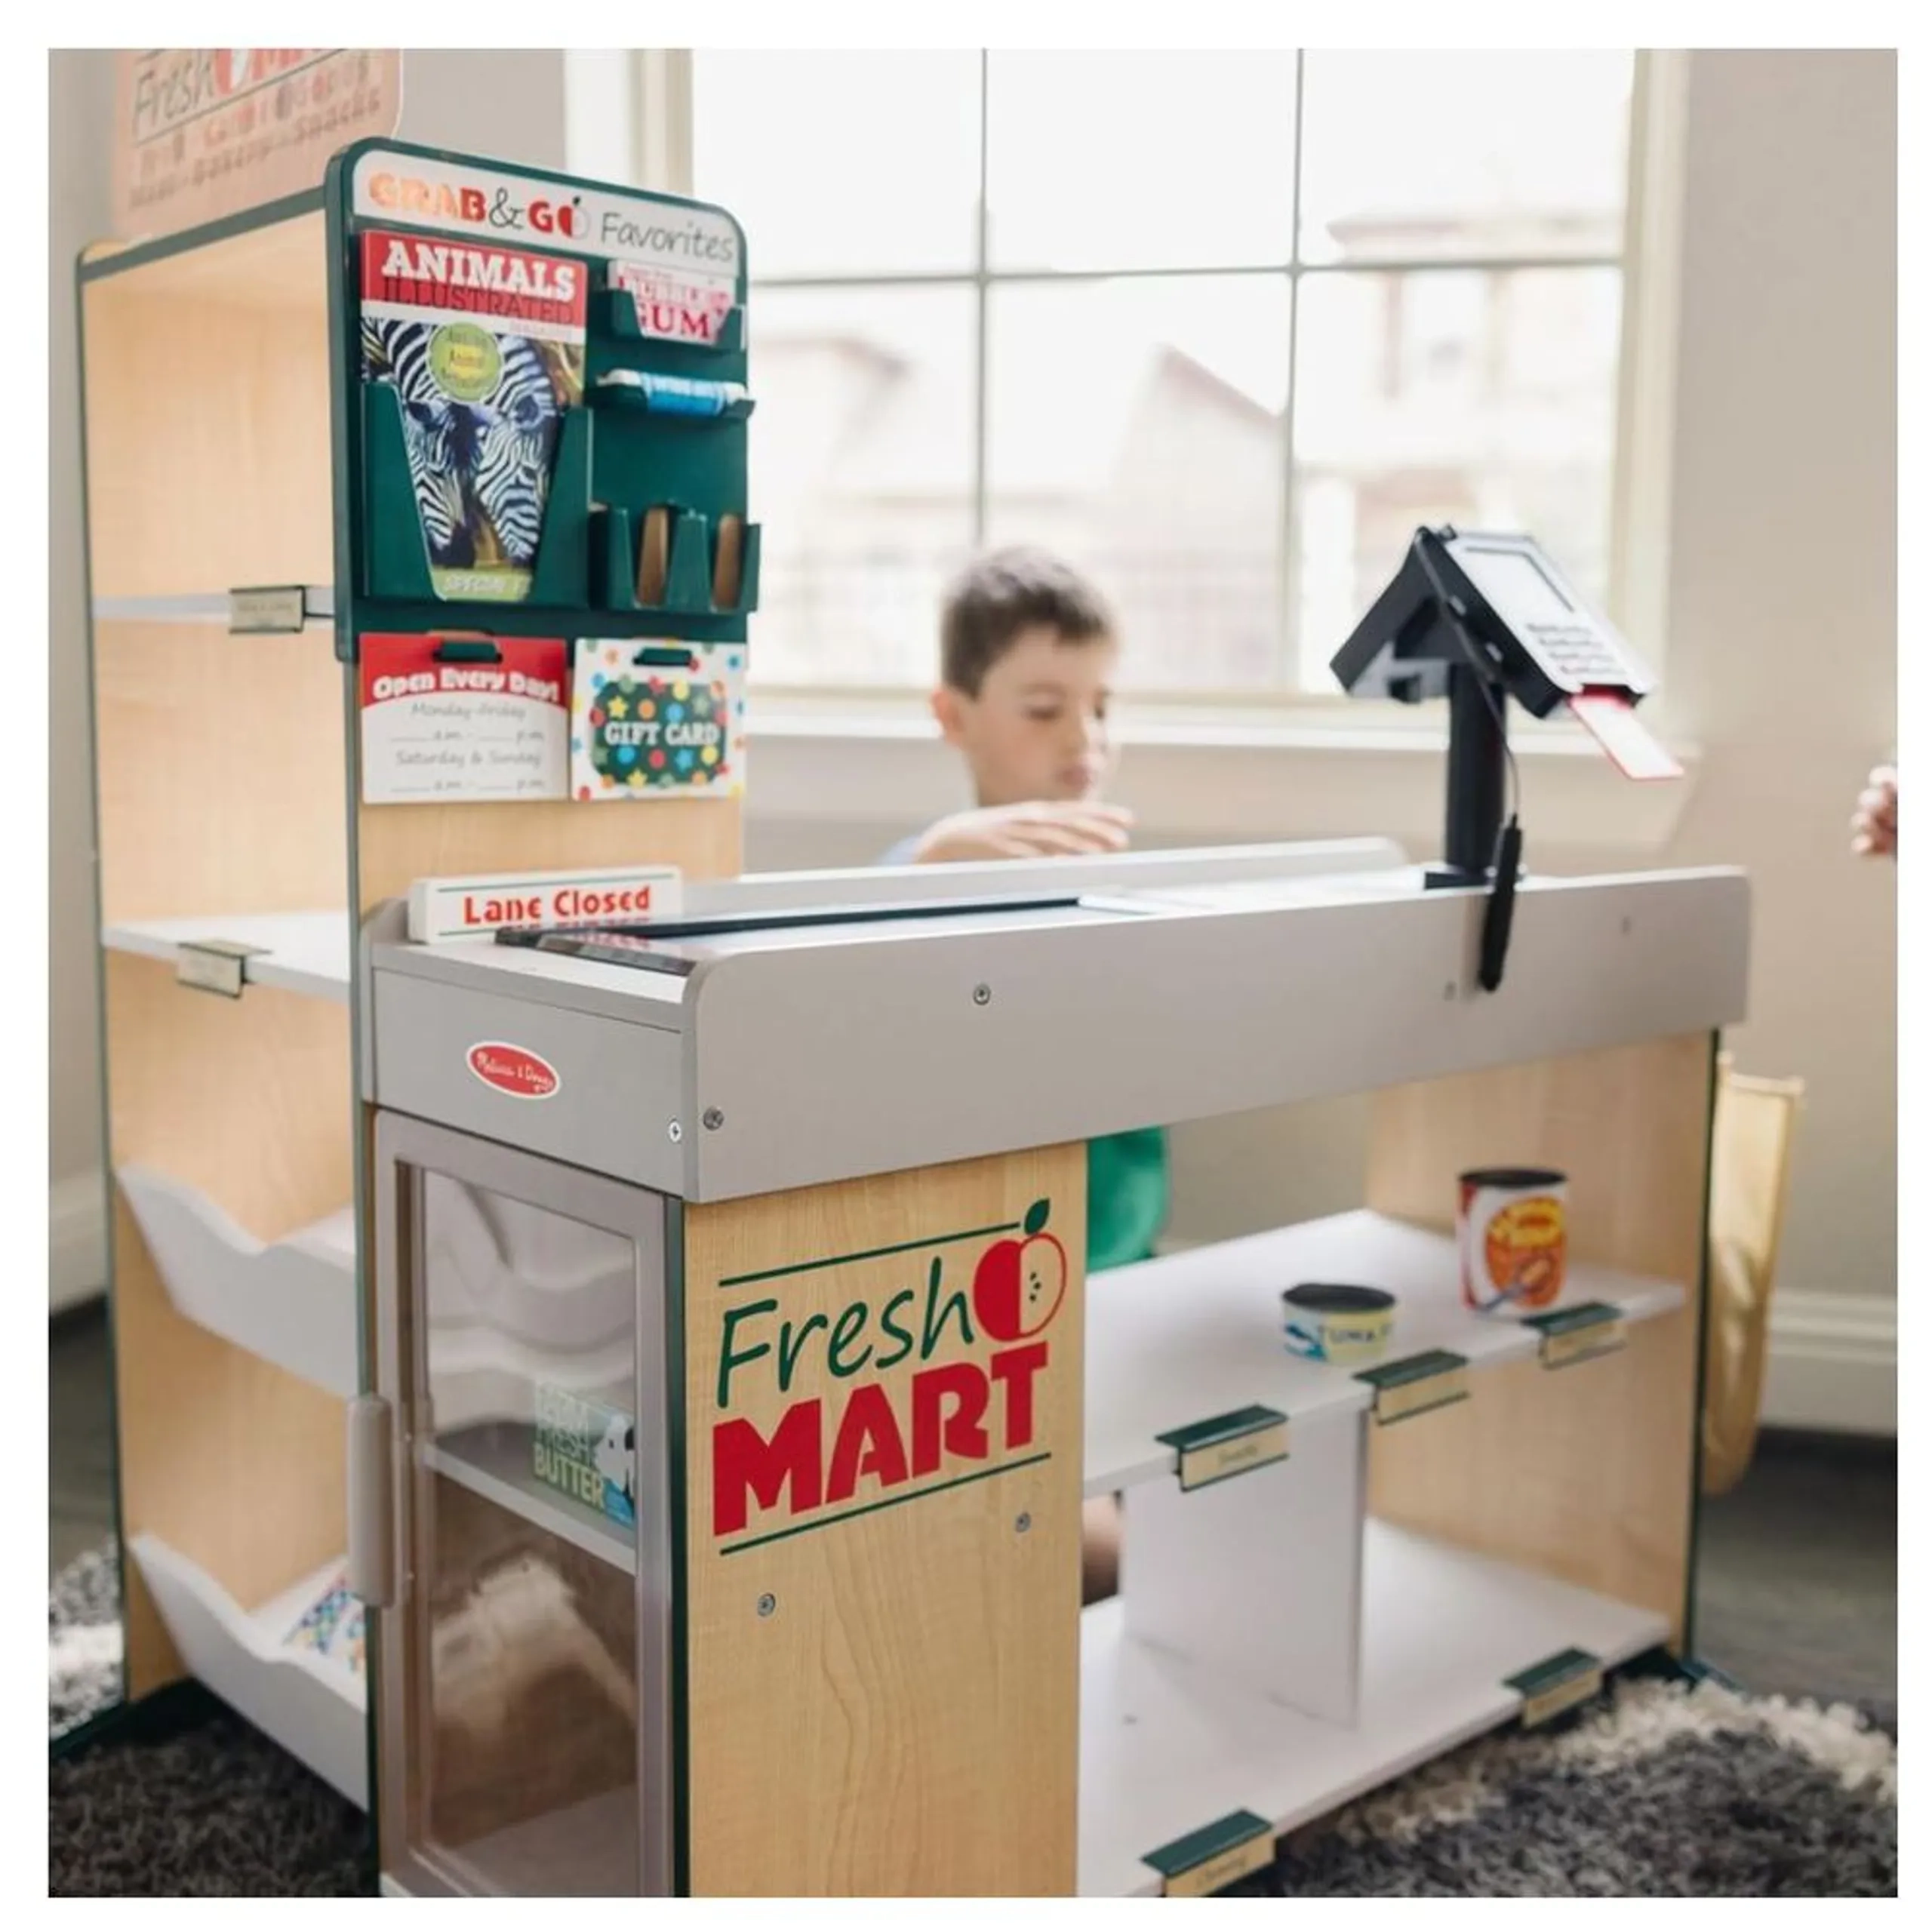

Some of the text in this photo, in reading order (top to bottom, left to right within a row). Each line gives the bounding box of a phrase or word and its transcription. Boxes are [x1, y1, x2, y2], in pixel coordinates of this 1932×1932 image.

[598, 211, 734, 262] Favorites
[381, 239, 577, 301] ANIMALS
[380, 277, 576, 326] ILLUSTRATED
[373, 671, 437, 699] Open
[439, 666, 506, 691] Every
[603, 720, 720, 747] GIFT CARD
[463, 884, 651, 925] Lane Closed
[717, 1255, 975, 1409] Fresh
[712, 1340, 1049, 1537] MART
[533, 1441, 605, 1512] BUTTER
